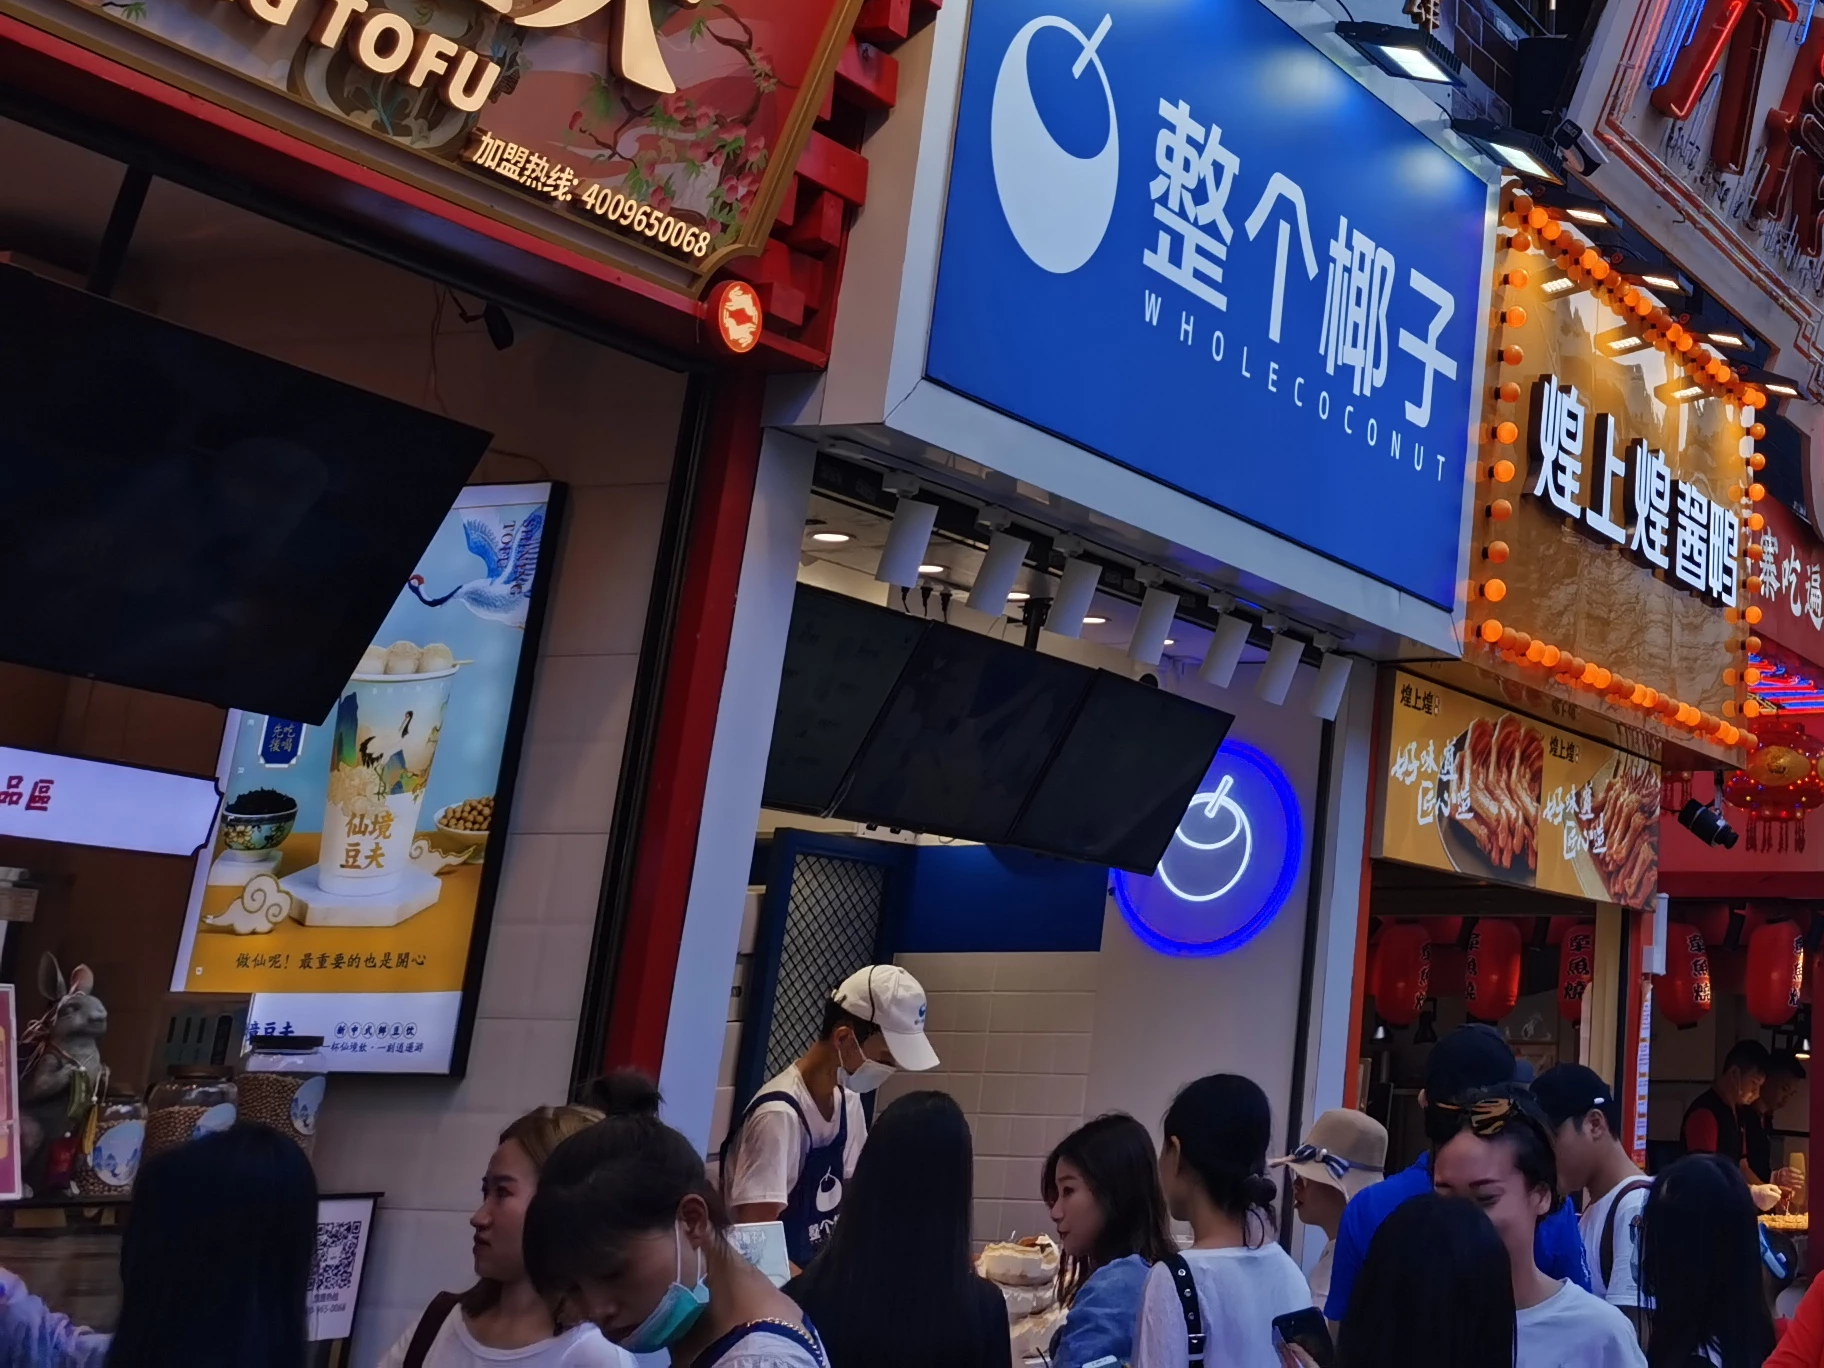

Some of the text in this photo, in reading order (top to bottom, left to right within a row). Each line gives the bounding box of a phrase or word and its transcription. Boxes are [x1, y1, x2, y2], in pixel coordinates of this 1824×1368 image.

[582, 181, 710, 260] 4009650068
[1143, 97, 1458, 429] 整个椰子
